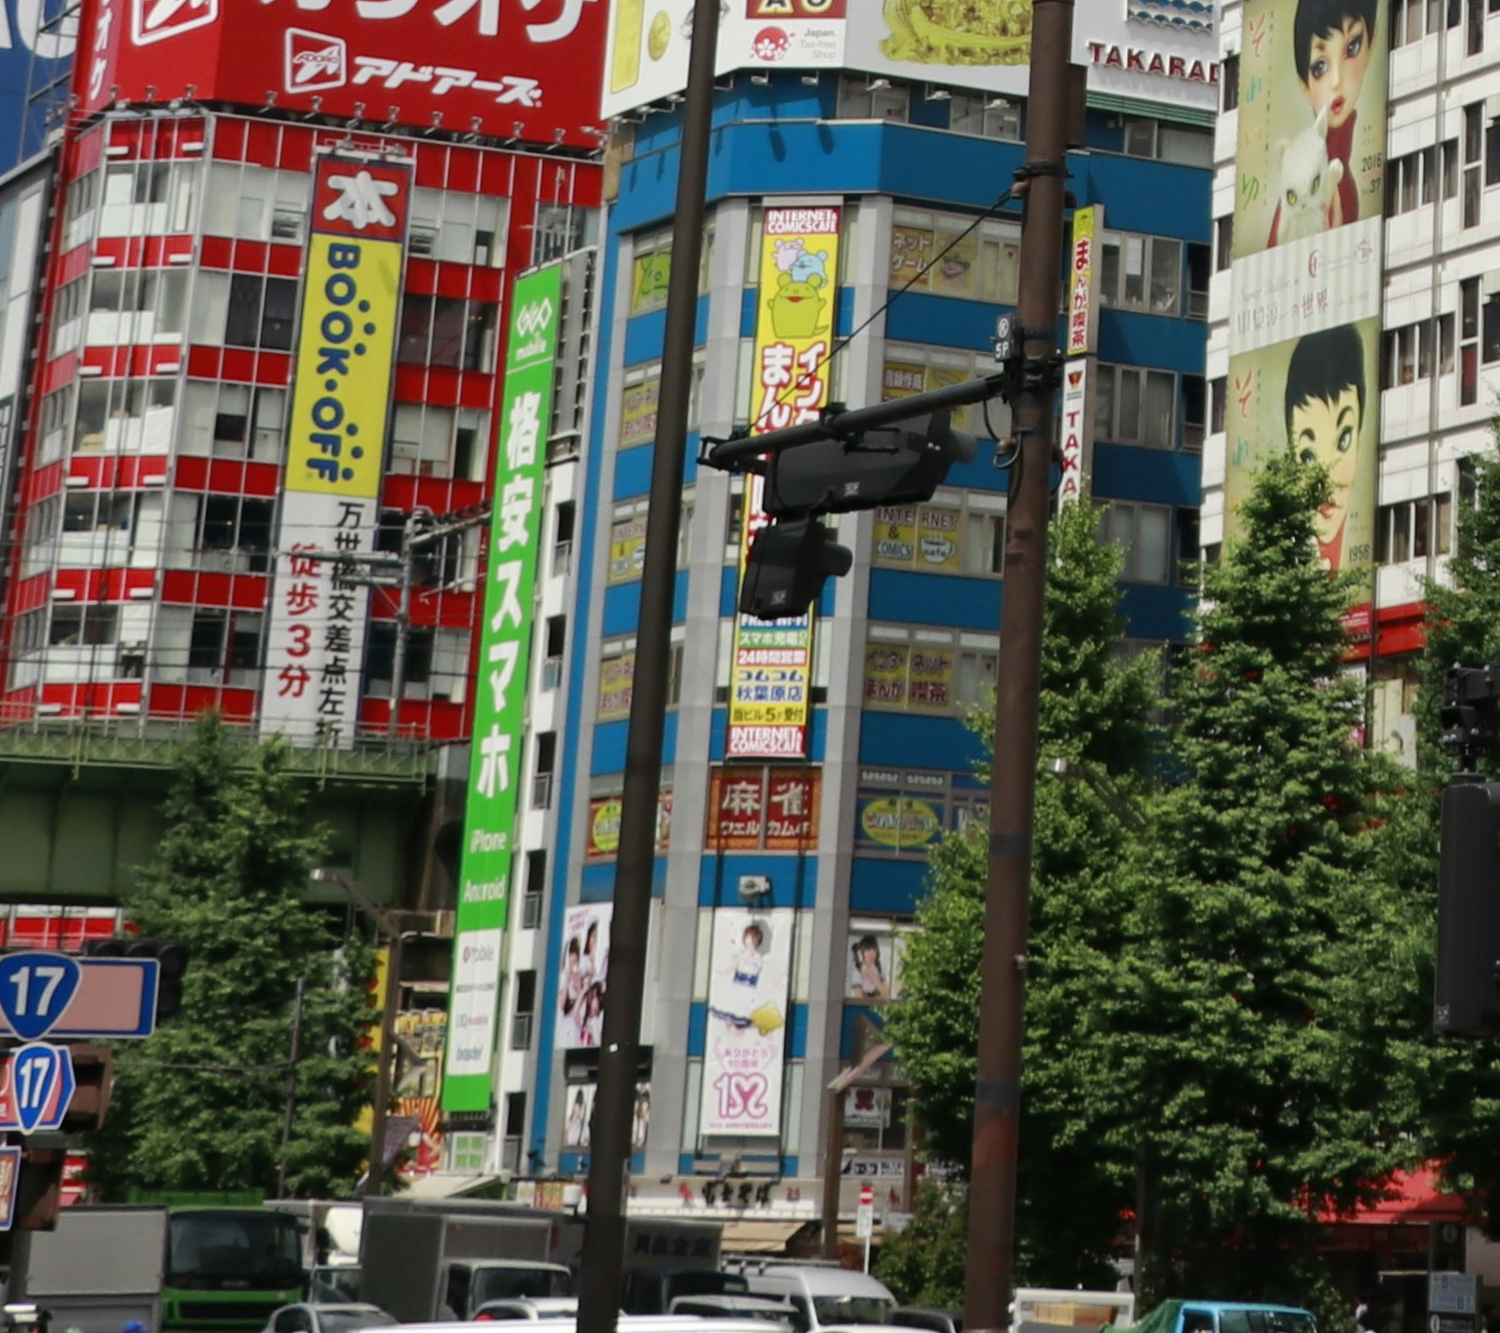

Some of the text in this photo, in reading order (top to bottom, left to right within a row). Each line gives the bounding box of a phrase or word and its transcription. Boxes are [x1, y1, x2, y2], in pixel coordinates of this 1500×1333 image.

[352, 55, 545, 108] アドアーズ
[1361, 155, 1382, 174] 2016
[322, 169, 398, 230] 本
[1071, 237, 1092, 350] まんが喫茶
[476, 390, 541, 799] 格安スマホ
[736, 686, 803, 702] 秋葉原店
[738, 669, 804, 682] コムコム
[722, 781, 808, 817] 麻雀
[9, 965, 65, 1016] 17
[19, 1056, 51, 1109] 17
